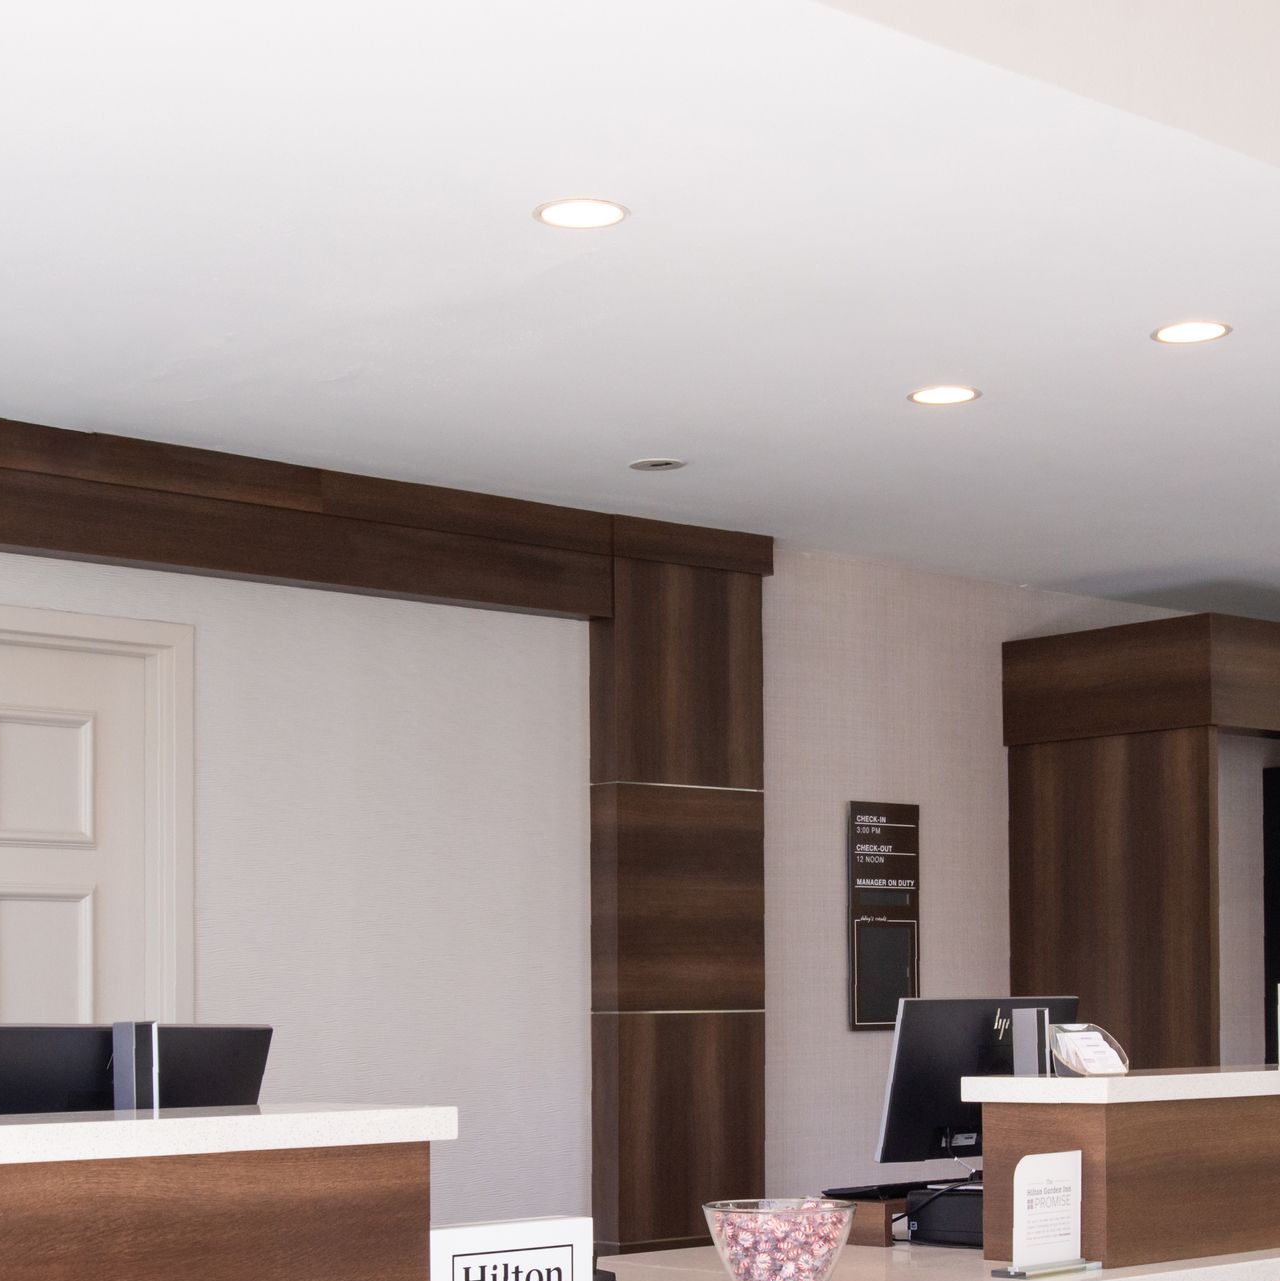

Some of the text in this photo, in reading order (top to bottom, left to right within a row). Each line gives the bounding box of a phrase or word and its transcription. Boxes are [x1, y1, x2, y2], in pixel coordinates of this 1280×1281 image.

[856, 815, 887, 823] CHECK-IN
[856, 826, 870, 834] 3:00
[856, 844, 893, 852] CHECK-OUT
[856, 855, 864, 863] 12
[856, 878, 887, 886] MANAGER
[898, 879, 915, 887] DUTY
[1035, 1194, 1071, 1209] PROMISE
